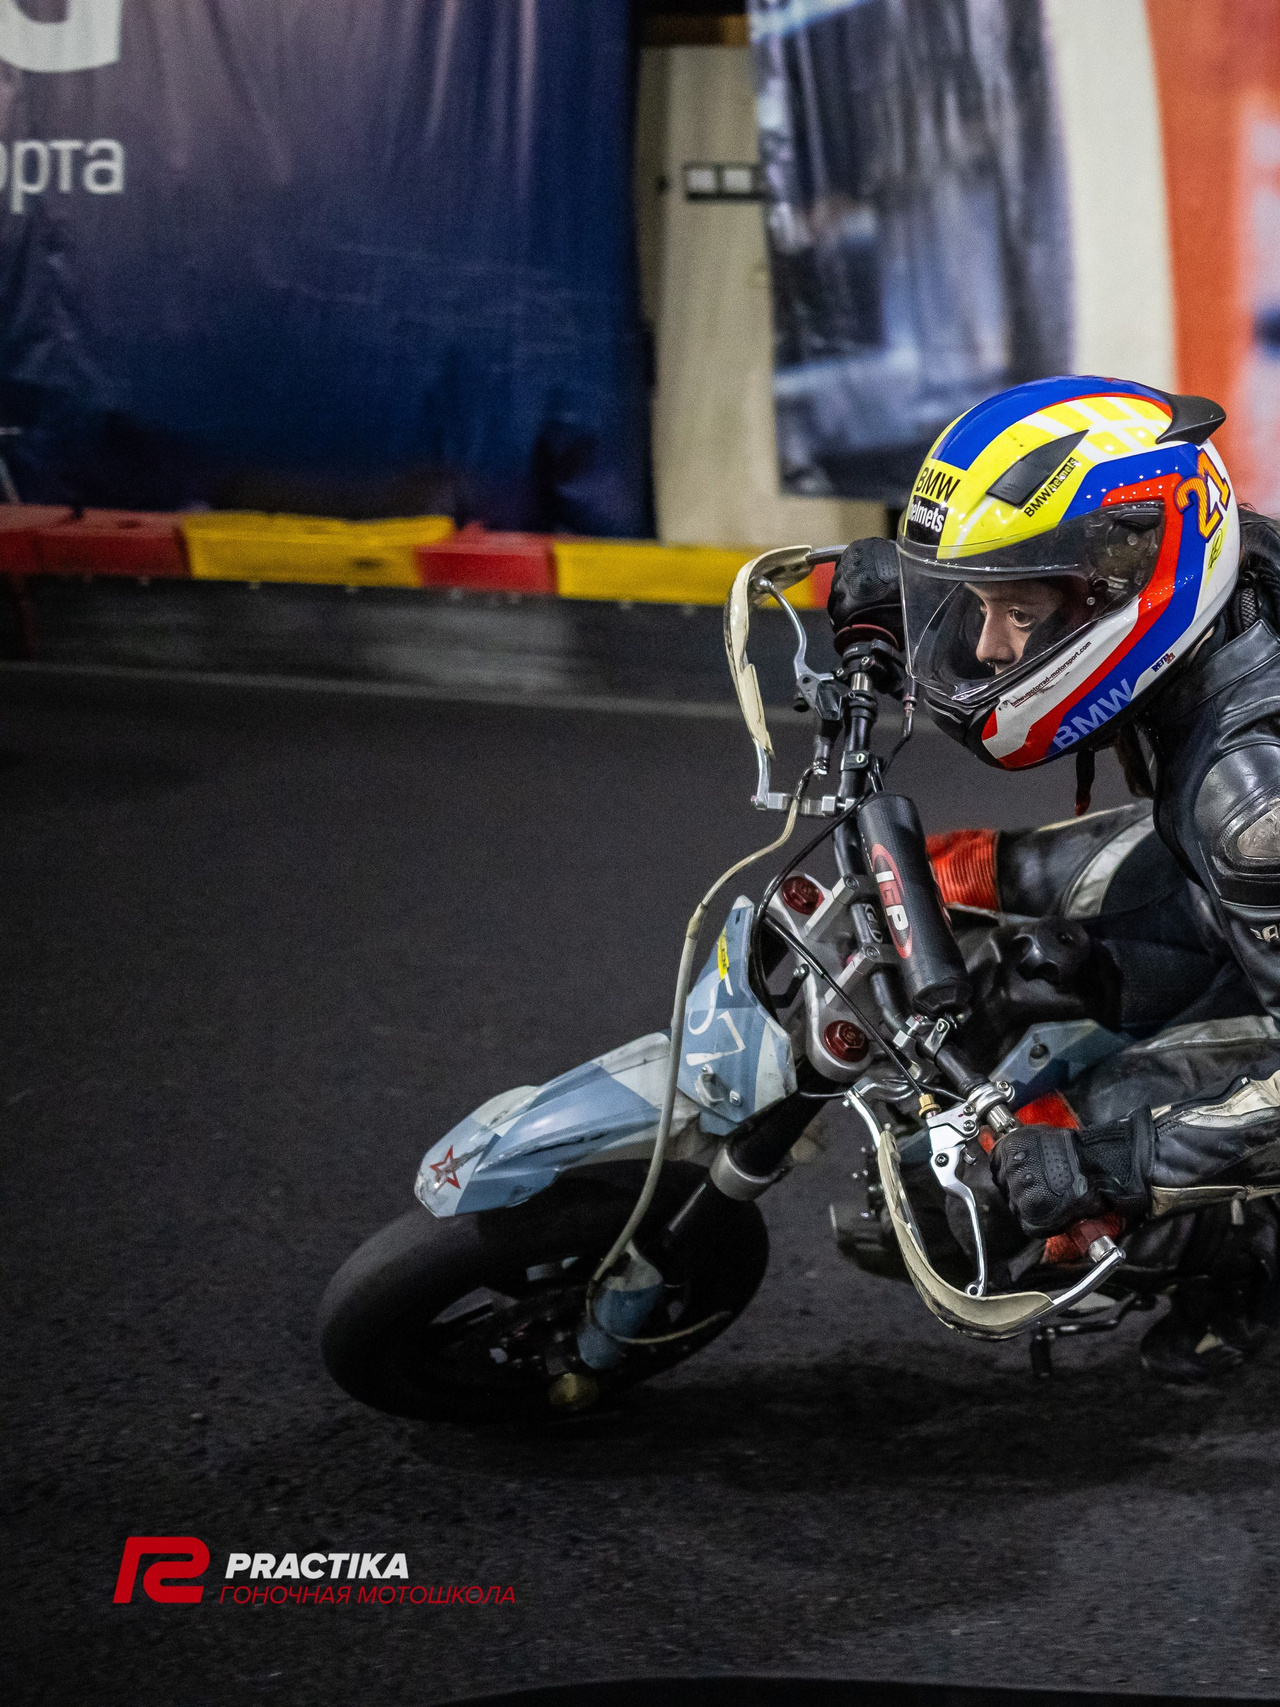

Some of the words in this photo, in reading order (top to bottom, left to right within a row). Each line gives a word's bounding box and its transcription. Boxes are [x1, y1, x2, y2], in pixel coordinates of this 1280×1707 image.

[0, 138, 125, 214] рта
[915, 467, 961, 503] BMW
[1174, 448, 1231, 543] 21
[1052, 678, 1134, 750] BMW
